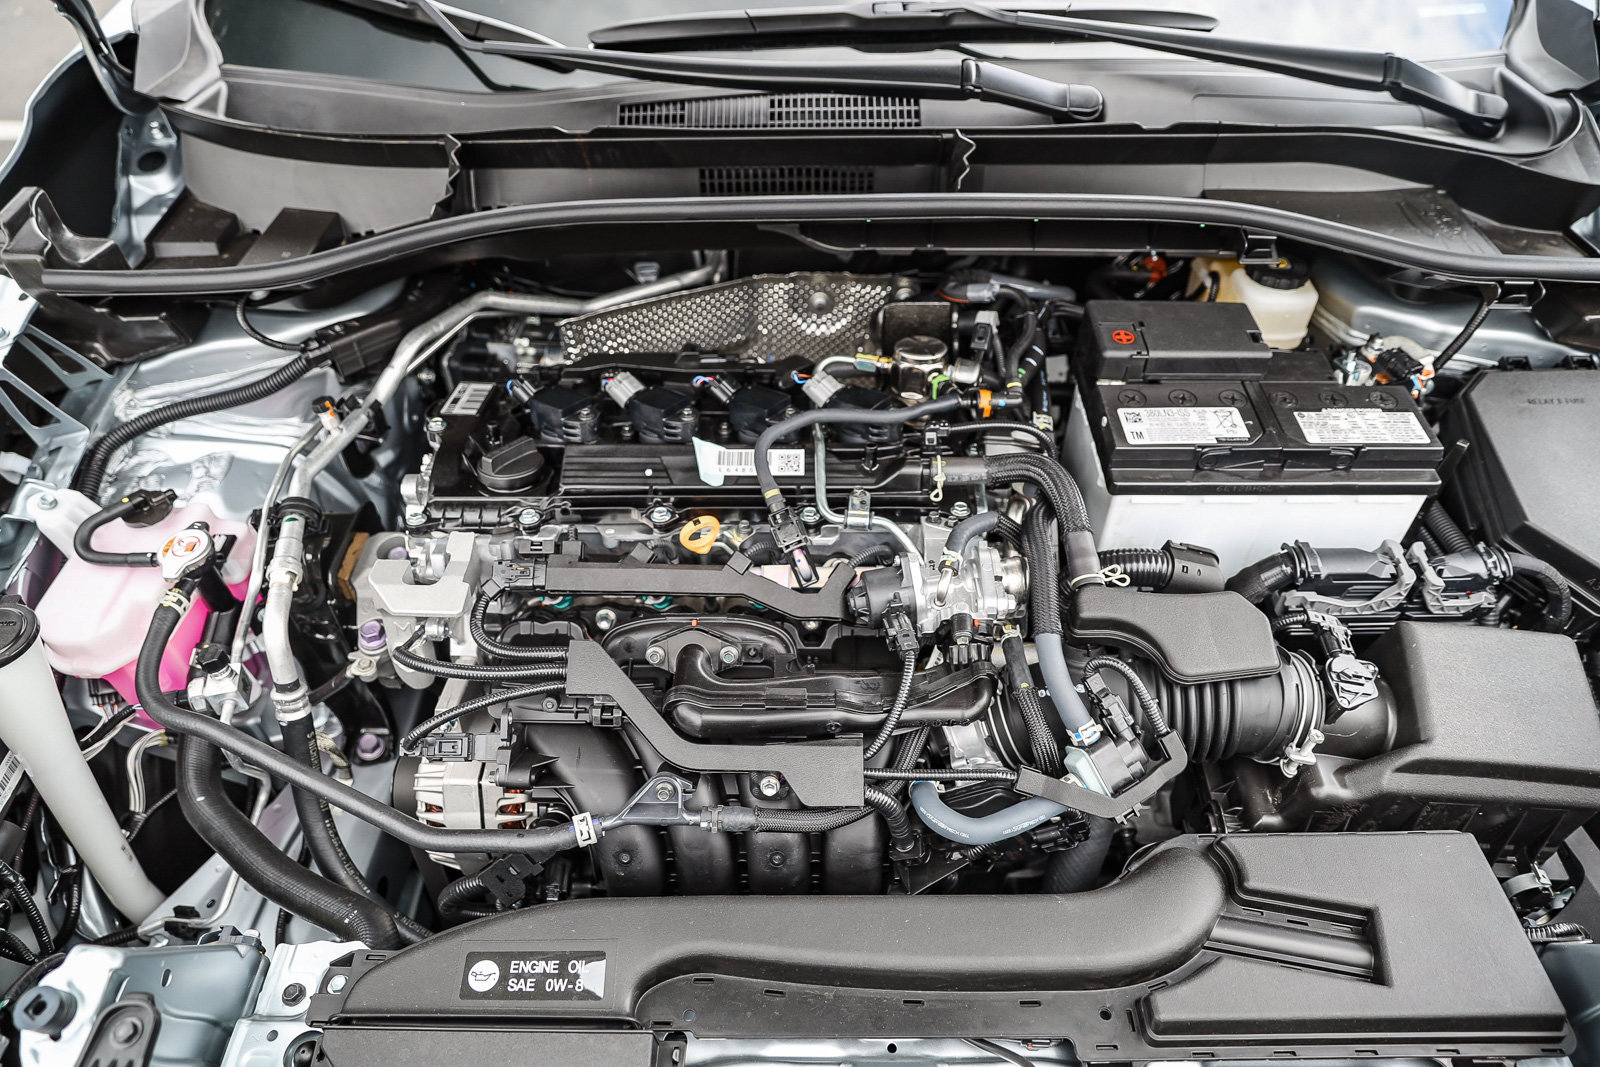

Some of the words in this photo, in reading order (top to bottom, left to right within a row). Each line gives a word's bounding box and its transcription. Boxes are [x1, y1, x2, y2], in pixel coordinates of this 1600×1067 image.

[1130, 431, 1145, 440] TM
[509, 960, 560, 974] ENGINE
[567, 960, 590, 974] OIL
[507, 978, 536, 992] SAE
[544, 978, 584, 992] 0W-8
